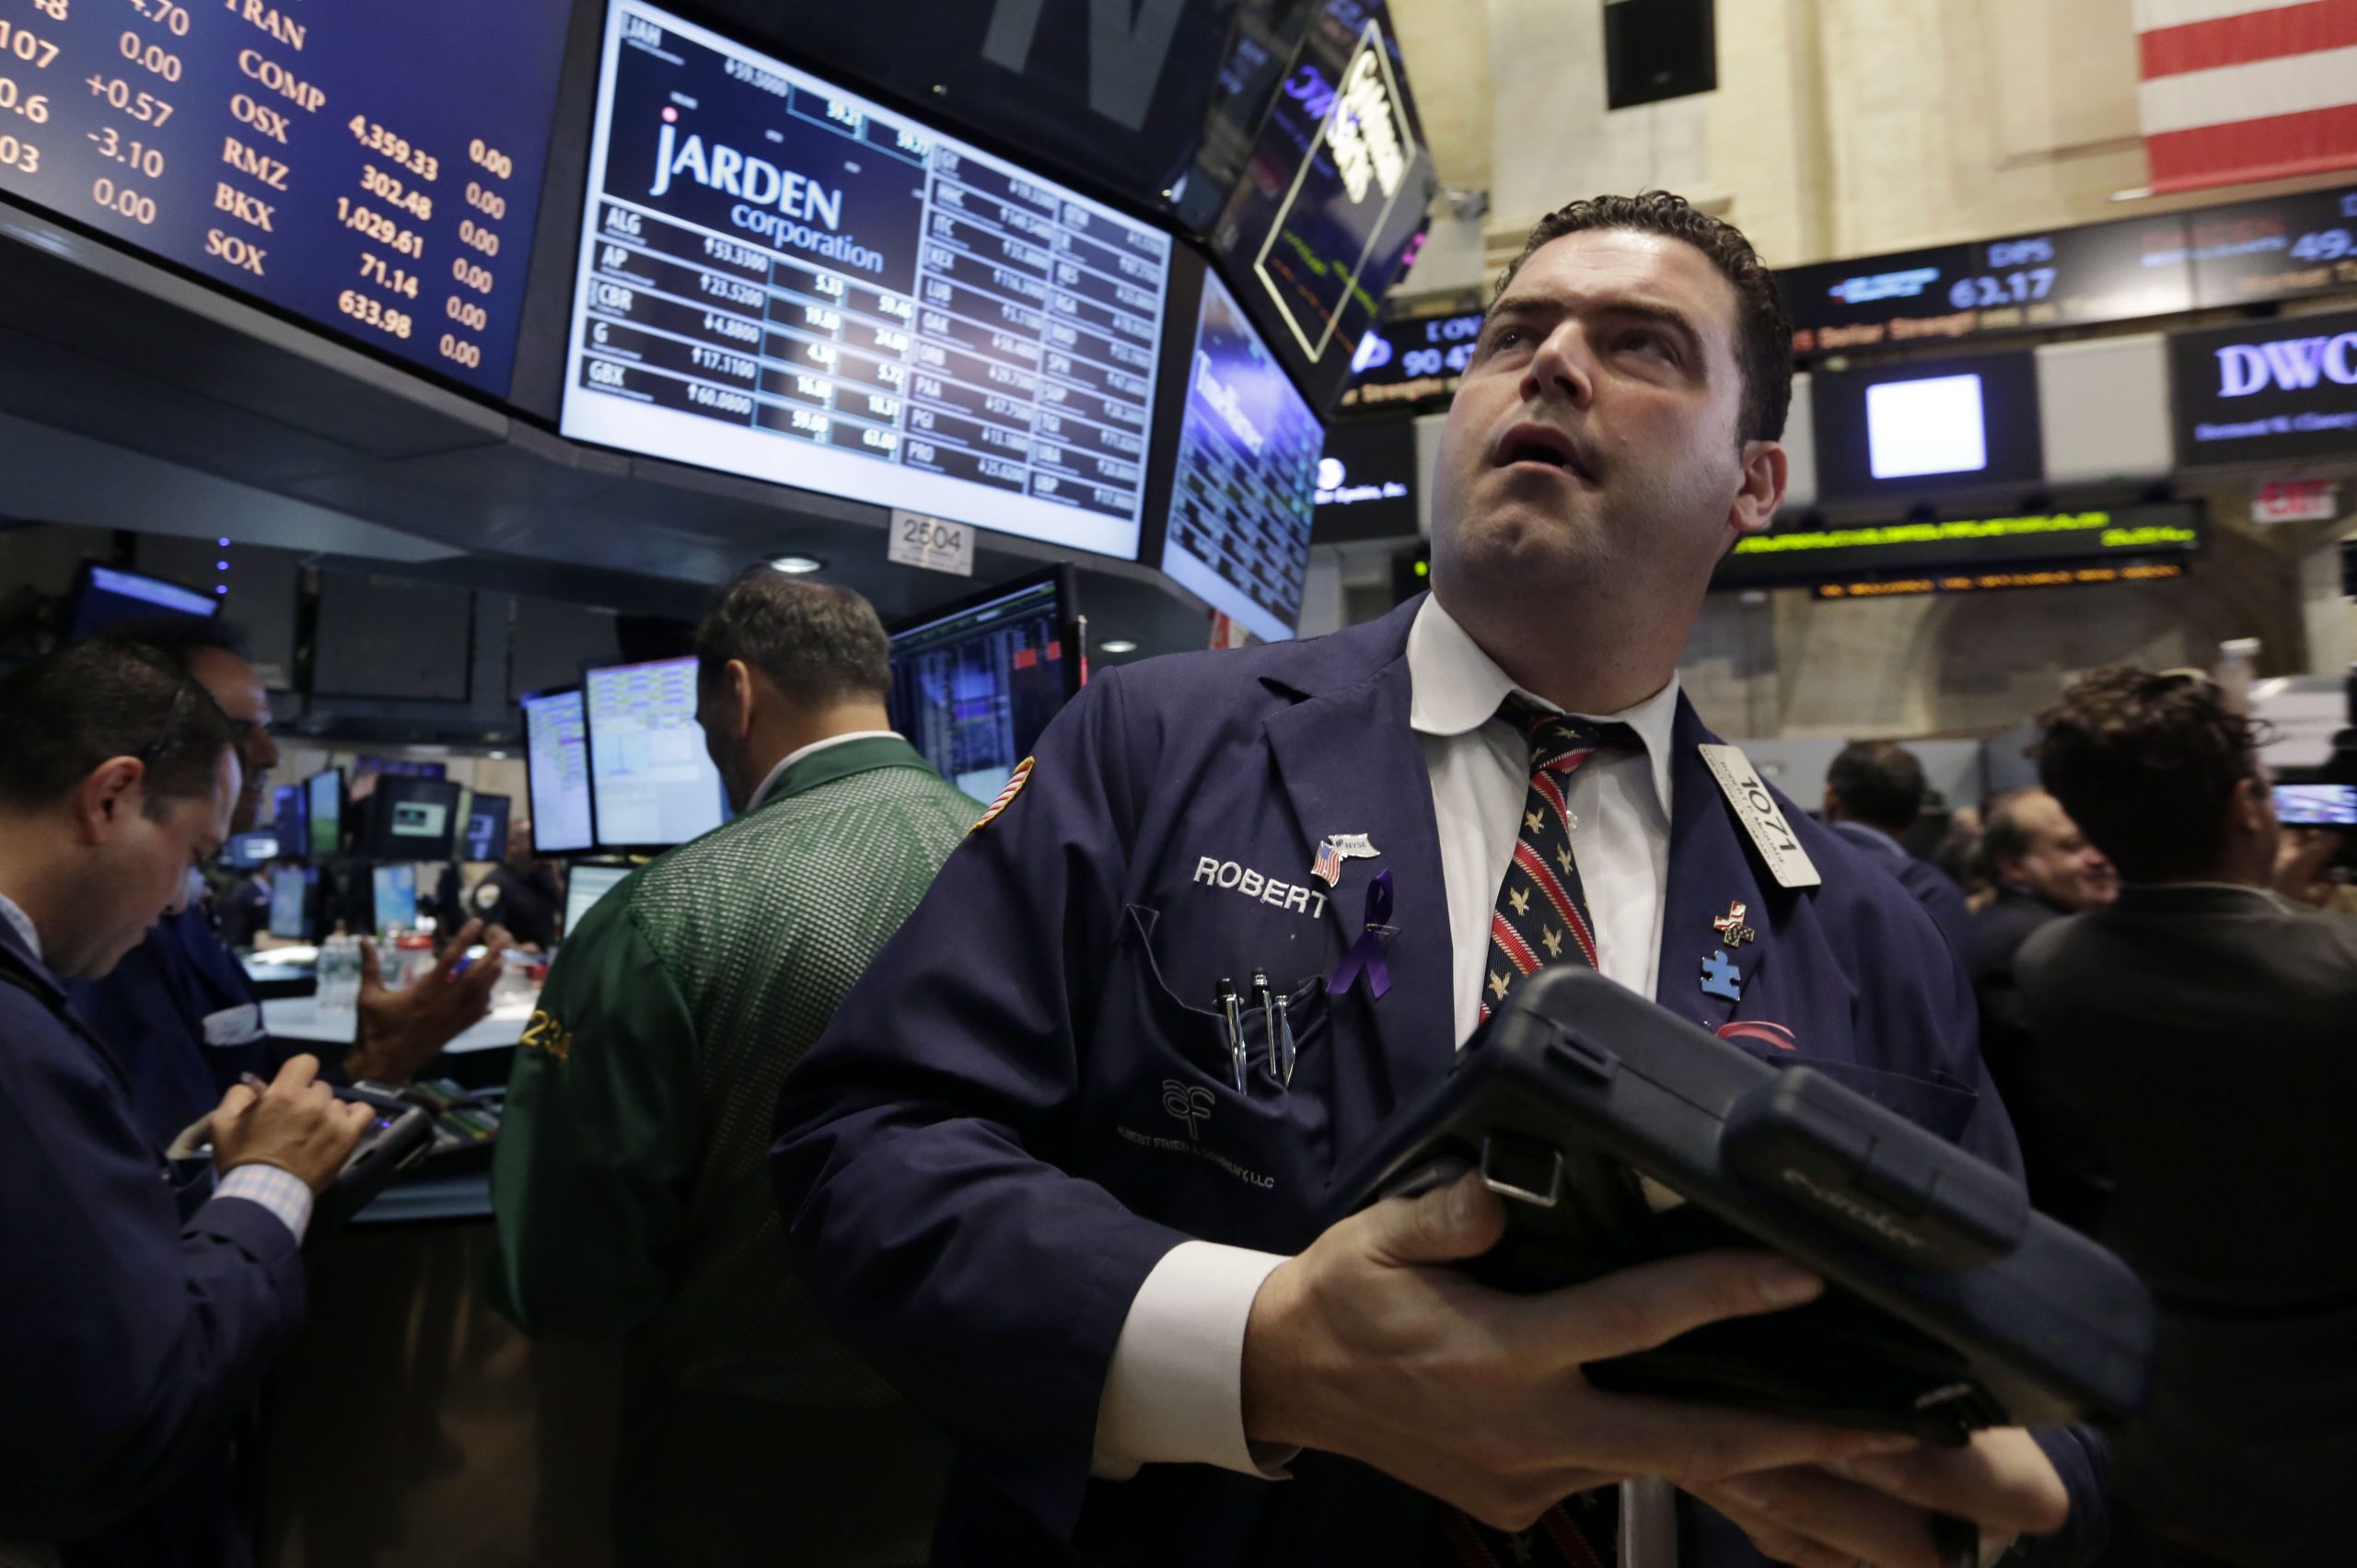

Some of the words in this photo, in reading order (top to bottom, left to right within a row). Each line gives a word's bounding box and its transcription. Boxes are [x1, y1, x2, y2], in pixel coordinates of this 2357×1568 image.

[120, 30, 182, 82] 0.00
[85, 74, 175, 127] +0.57
[87, 127, 165, 178] -3.10
[238, 49, 326, 112] COMP
[348, 114, 439, 181] 4,359.33
[465, 181, 505, 220] 0.00
[468, 138, 512, 180] 0.00
[229, 94, 290, 145] OSX
[360, 164, 433, 221] 302.48
[459, 219, 499, 257] 0.00
[92, 178, 157, 225] 0.00
[222, 136, 290, 192] RMZ
[337, 196, 424, 260] 1,029.61
[452, 257, 493, 295] 0.00
[605, 206, 642, 236] ALG
[214, 181, 275, 233] BKX
[360, 252, 418, 300] 71.14
[446, 296, 486, 331] 0.00
[601, 245, 629, 269] AP
[730, 202, 885, 273] corporation
[204, 227, 268, 276] SOX
[338, 289, 412, 339] 633.98
[439, 333, 481, 369] 0.00
[598, 283, 633, 311] CBR
[593, 321, 609, 343] G
[588, 359, 626, 388] GBX
[903, 518, 961, 552] 2504
[1741, 775, 1797, 850] 1071
[1345, 841, 1367, 849] NYSE
[1193, 856, 1329, 919] ROBERT
[1250, 1172, 1275, 1188] LLC
